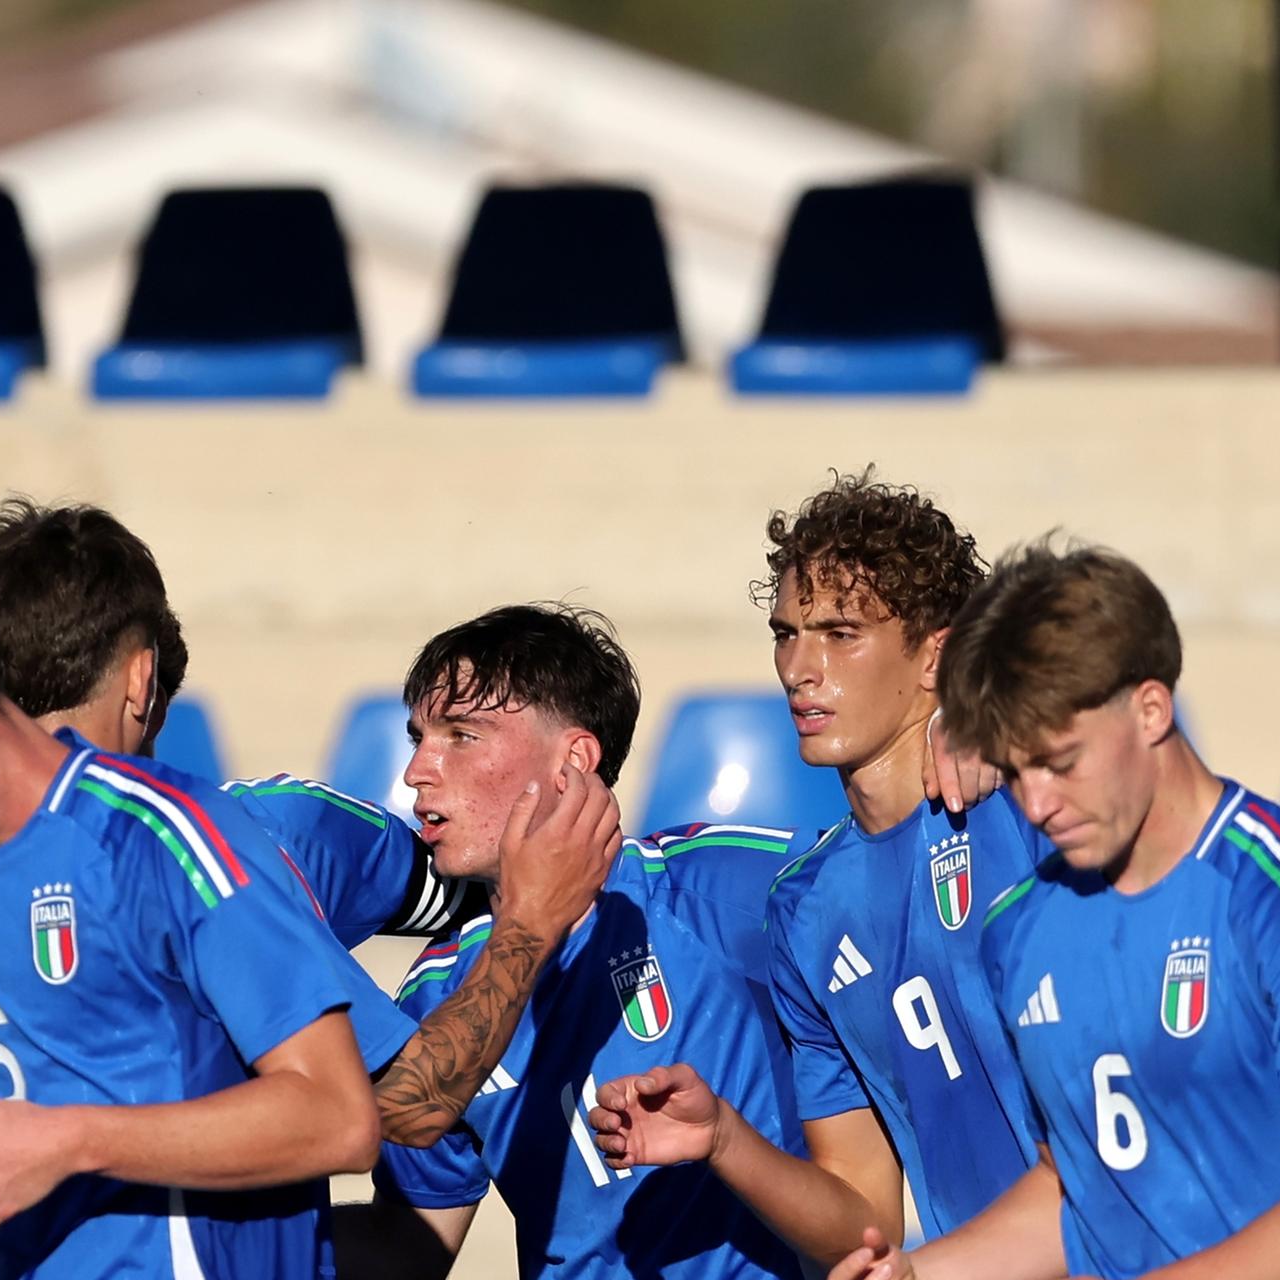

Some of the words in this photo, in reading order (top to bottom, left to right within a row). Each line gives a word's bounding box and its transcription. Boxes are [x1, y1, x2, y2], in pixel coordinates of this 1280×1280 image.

[934, 851, 967, 878] ITALIA
[35, 903, 70, 923] ITALIA
[616, 962, 658, 990] ITALIA
[1168, 957, 1205, 976] ITALIA
[892, 975, 963, 1081] 9
[1092, 1054, 1148, 1171] 6
